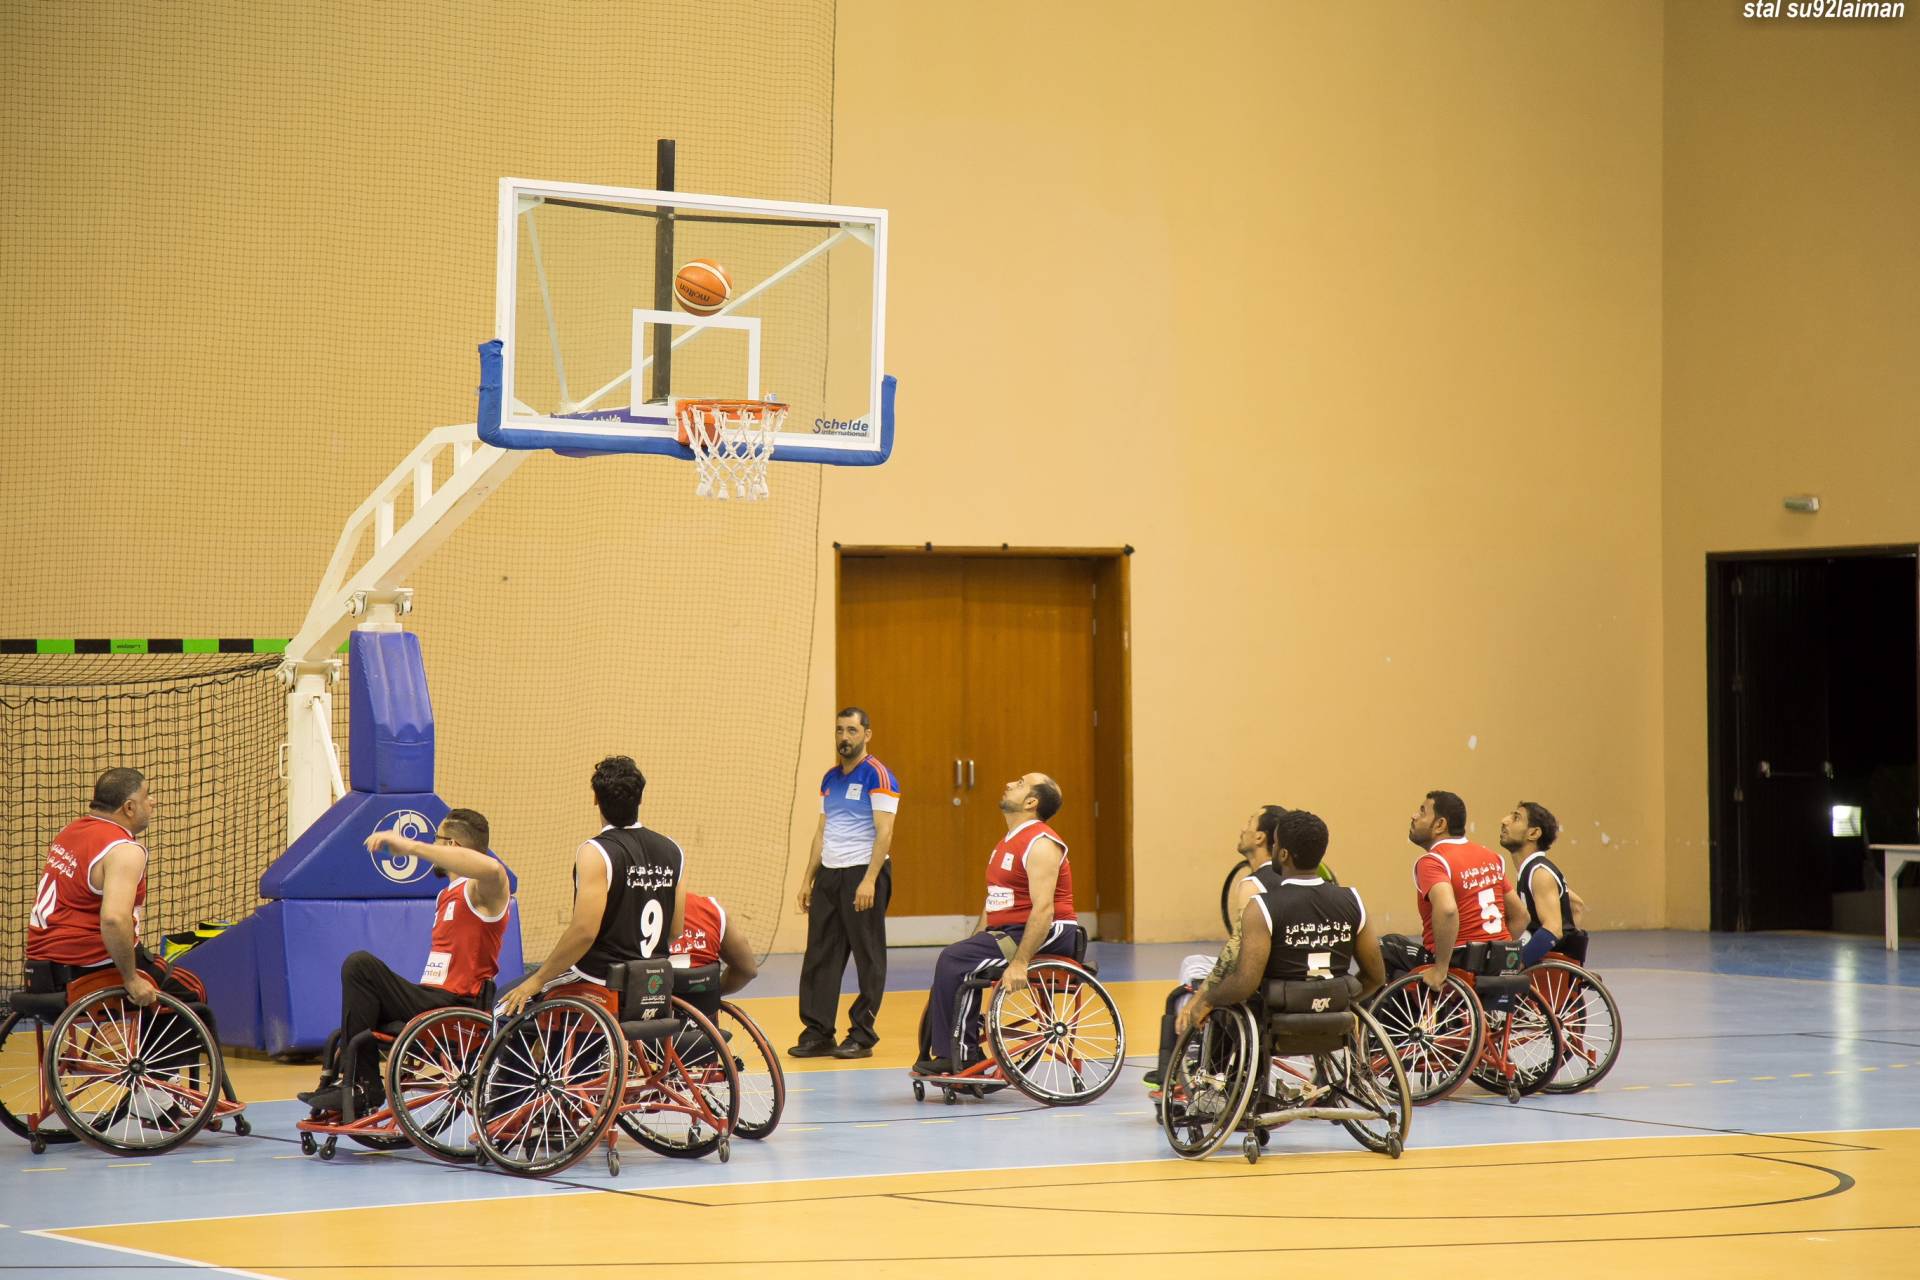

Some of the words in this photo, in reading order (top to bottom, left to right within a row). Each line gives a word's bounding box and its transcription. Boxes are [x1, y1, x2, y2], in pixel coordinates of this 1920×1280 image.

[812, 418, 869, 433] Schelde
[640, 899, 664, 958] 9
[1478, 888, 1503, 934] 5
